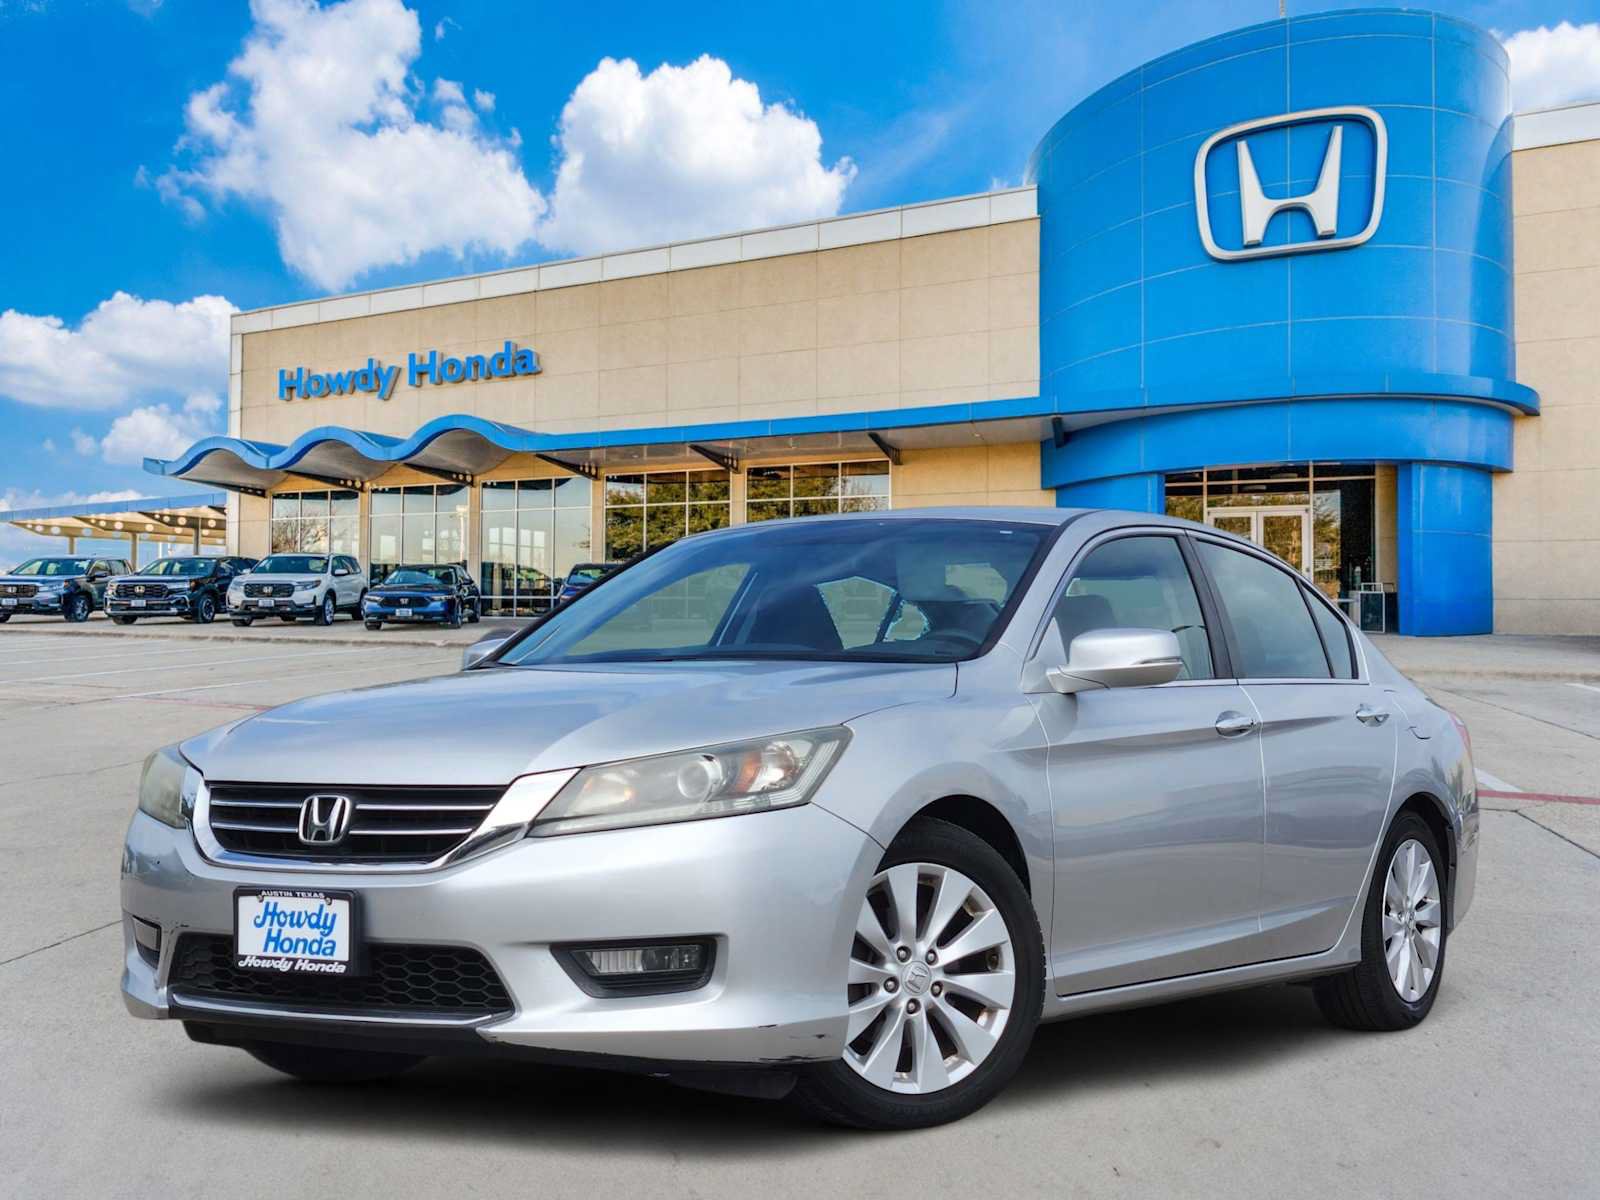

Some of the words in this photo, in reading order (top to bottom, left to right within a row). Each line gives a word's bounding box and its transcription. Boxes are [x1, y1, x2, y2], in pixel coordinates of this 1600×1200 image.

[278, 358, 400, 401] Howdy
[408, 340, 541, 388] Honda
[296, 891, 325, 899] TEXAS
[253, 901, 337, 937] Howdy
[262, 928, 337, 957] Honda
[238, 956, 293, 972] Howdy
[294, 957, 346, 973] Honda
